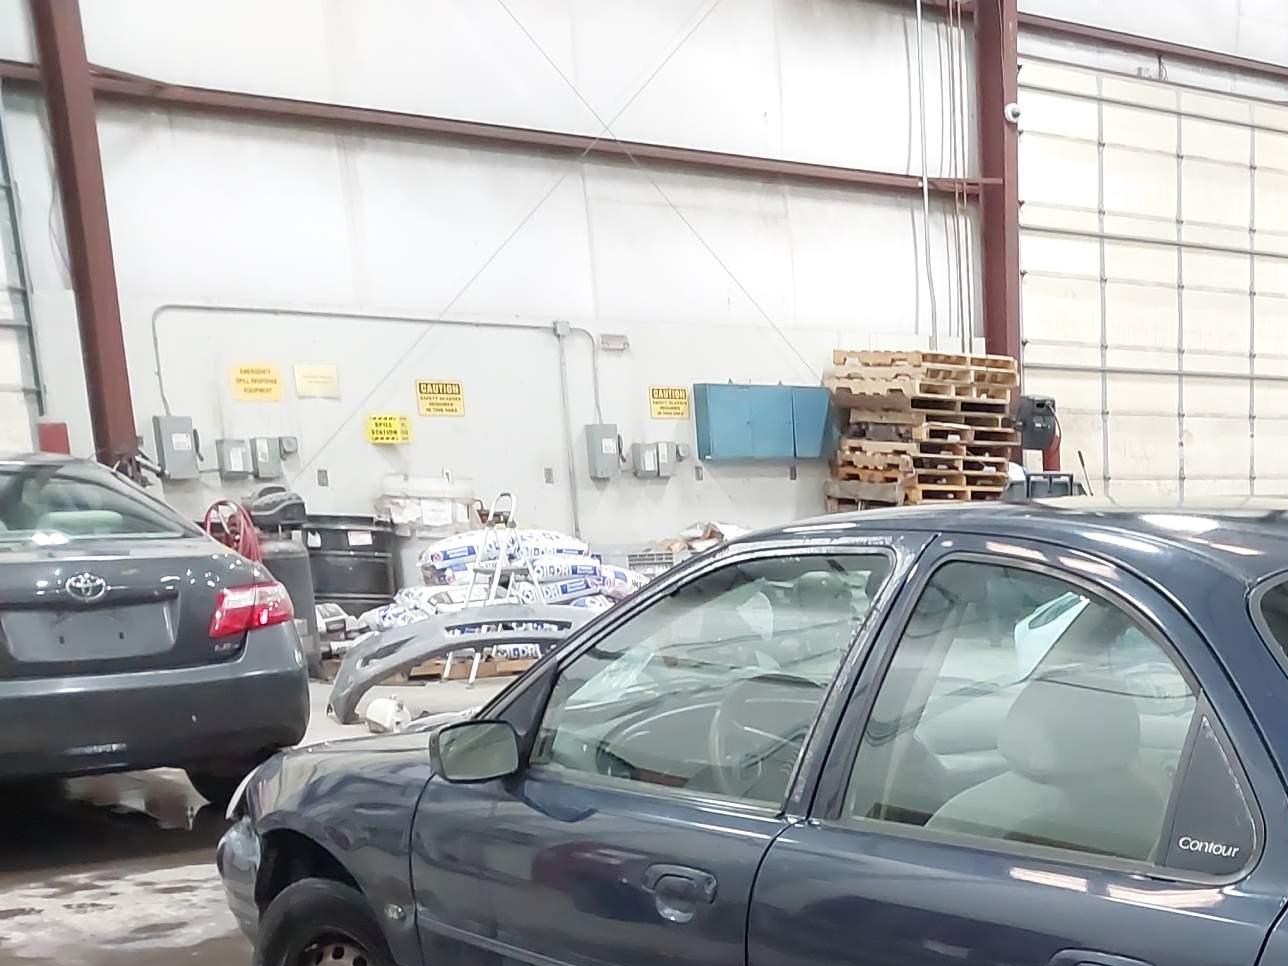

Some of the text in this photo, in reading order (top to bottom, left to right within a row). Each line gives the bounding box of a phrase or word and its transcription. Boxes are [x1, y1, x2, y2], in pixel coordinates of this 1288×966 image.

[420, 383, 460, 394] CAUTION
[652, 388, 687, 400] CAUTION
[1178, 836, 1240, 858] Contour
